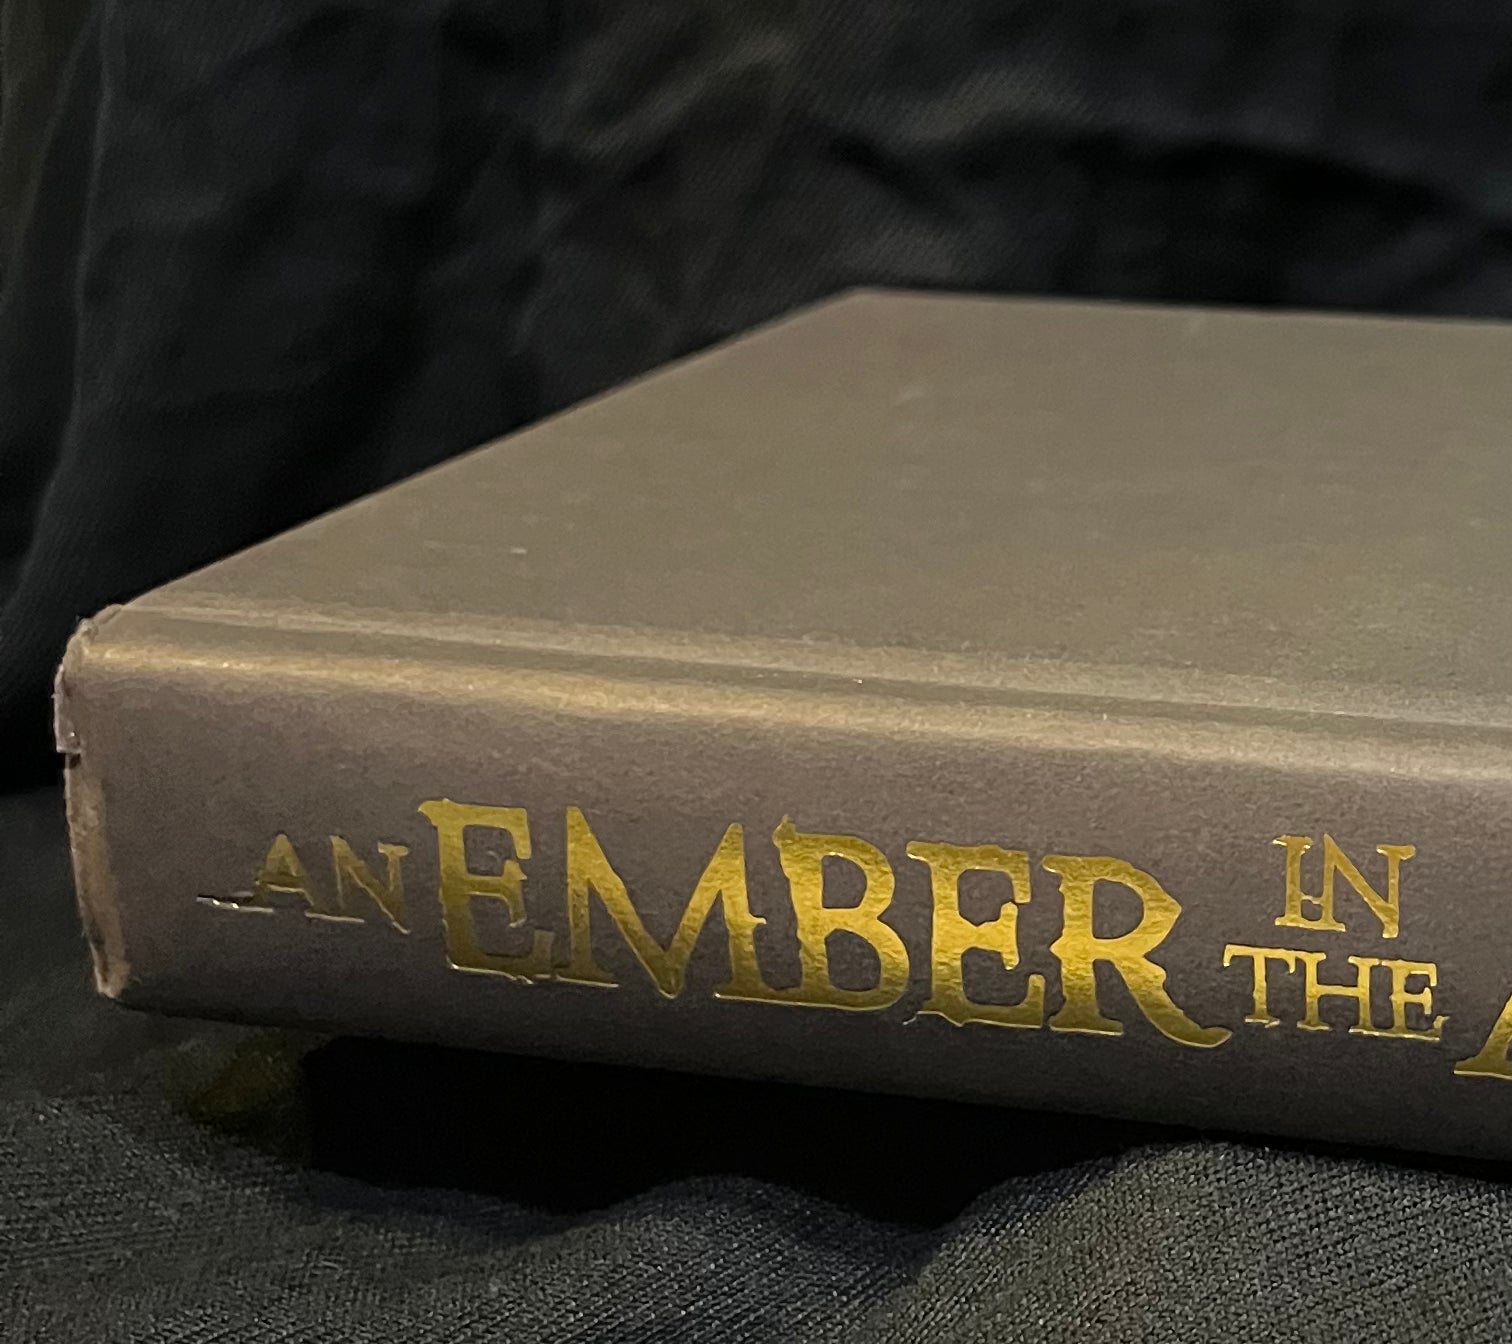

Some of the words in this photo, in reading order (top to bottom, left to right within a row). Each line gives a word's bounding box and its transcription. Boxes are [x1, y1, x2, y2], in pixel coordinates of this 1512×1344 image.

[196, 832, 410, 935] AN
[417, 798, 1233, 1048] EMBER
[1271, 833, 1417, 940] IN
[1222, 943, 1450, 1041] THE
